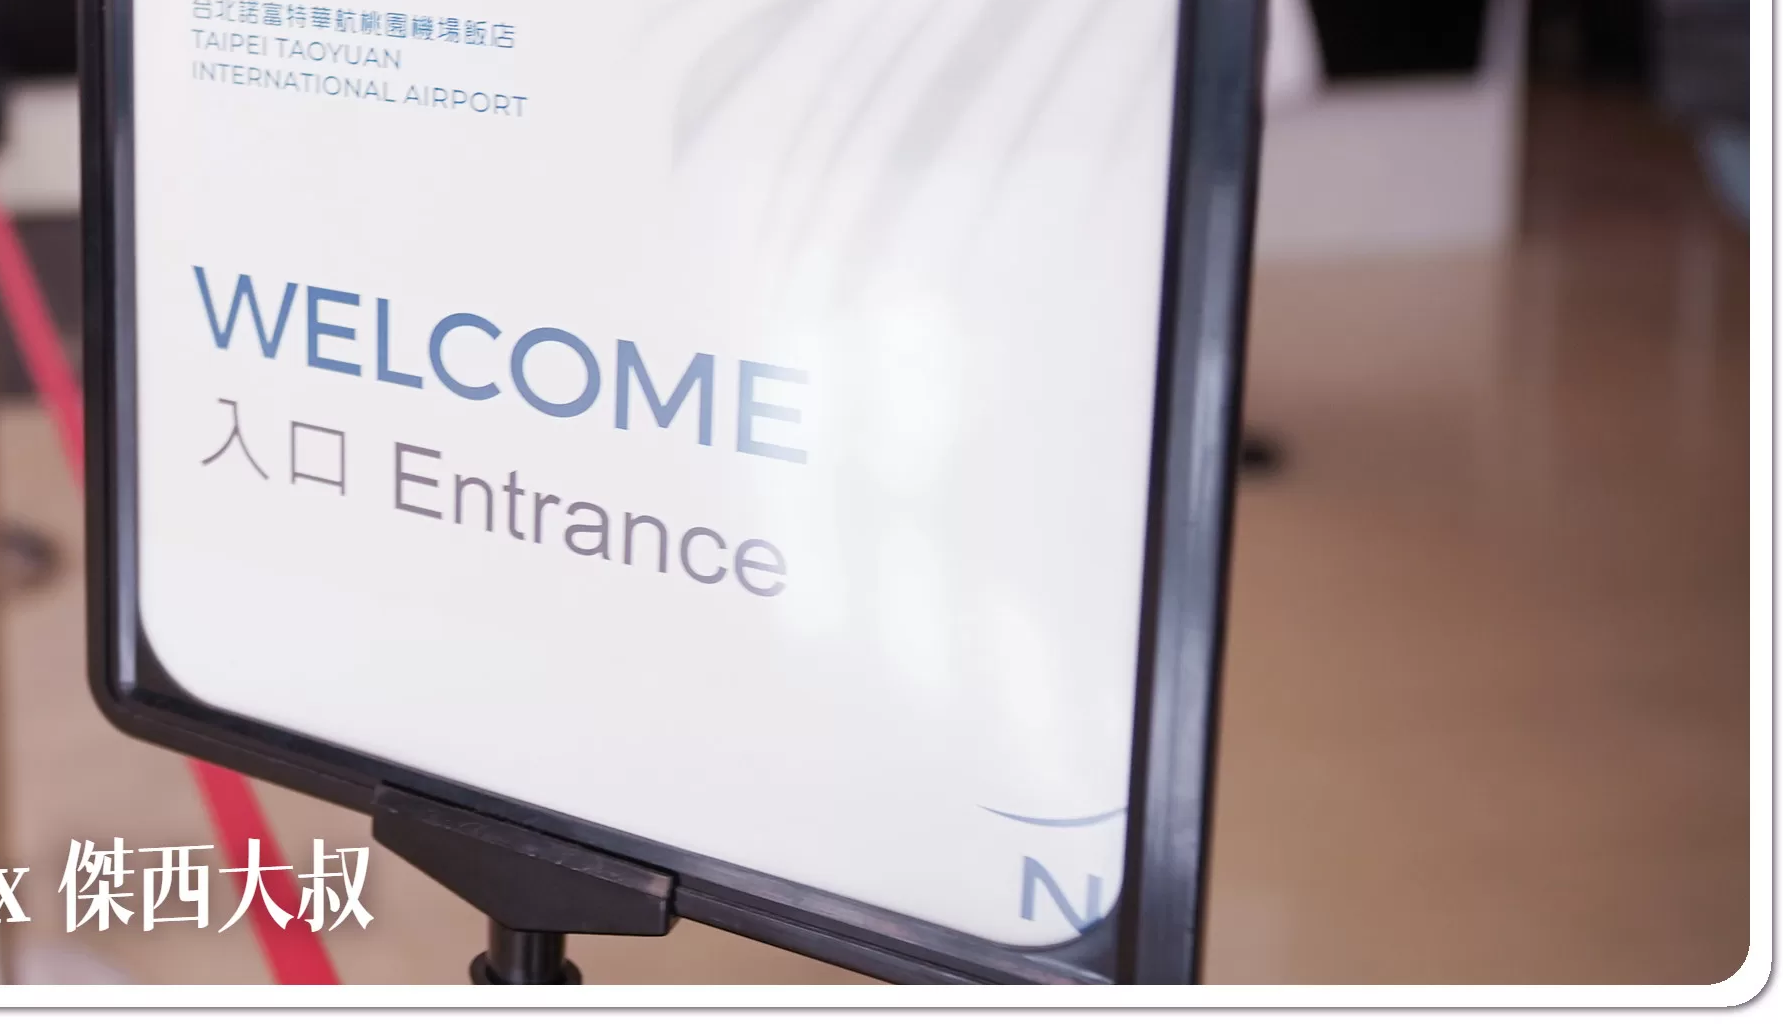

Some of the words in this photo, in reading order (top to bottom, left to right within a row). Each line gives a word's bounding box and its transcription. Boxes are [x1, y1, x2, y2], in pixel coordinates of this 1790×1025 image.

[191, 28, 268, 57] TAIPEI
[276, 37, 403, 70] TAOYUAN
[191, 60, 397, 103] INTERNATIONAL
[403, 84, 529, 118] AIRPORT
[191, 264, 810, 465] WELCOME
[201, 397, 346, 496] 入口
[393, 440, 789, 598] Entrance
